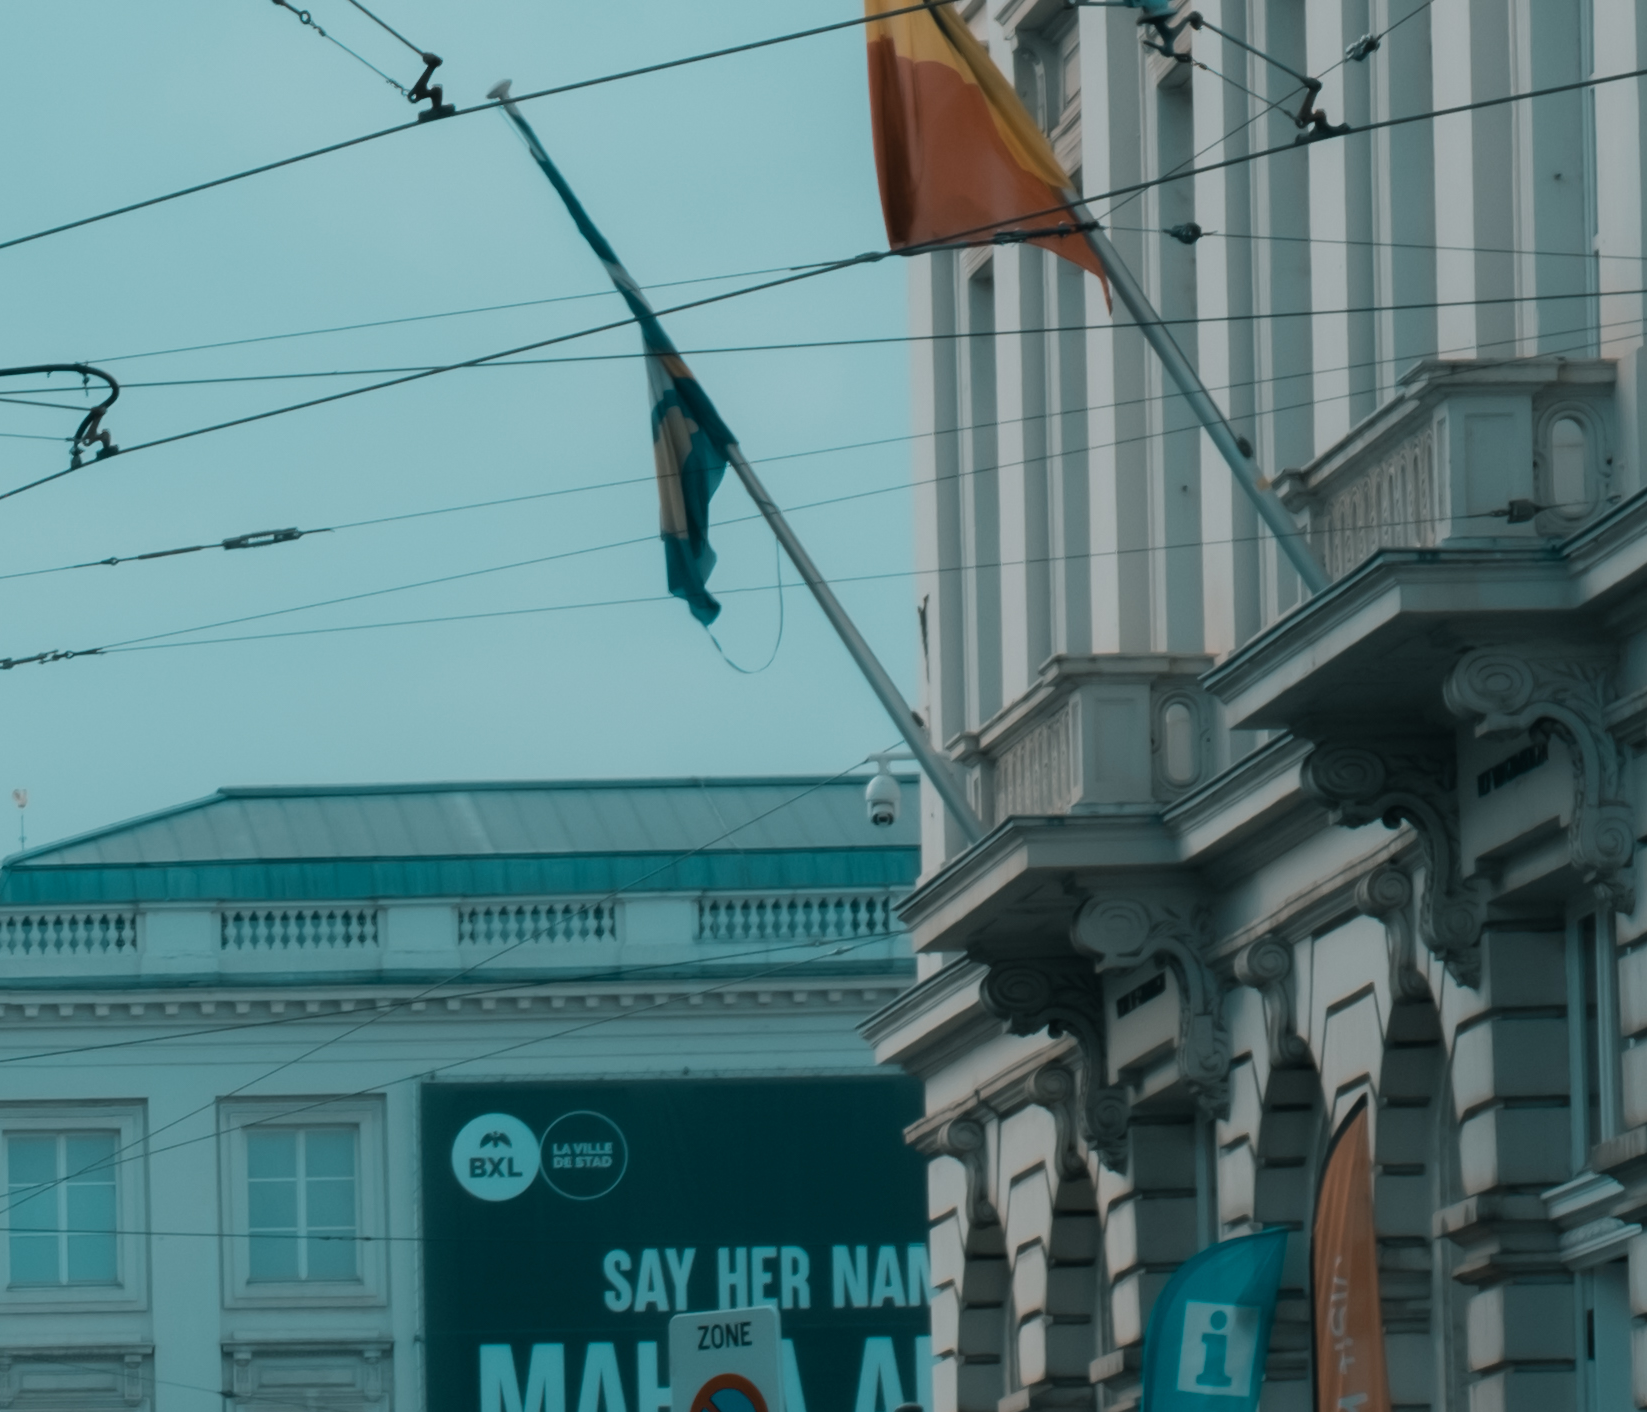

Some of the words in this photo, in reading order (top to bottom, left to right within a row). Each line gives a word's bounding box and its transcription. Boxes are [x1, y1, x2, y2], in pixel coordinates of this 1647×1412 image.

[553, 1143, 571, 1155] LA
[573, 1142, 613, 1154] VILLE
[469, 1157, 523, 1178] BXL
[553, 1157, 572, 1168] DE
[575, 1156, 612, 1168] STAD
[603, 1247, 696, 1312] SAY
[718, 1245, 811, 1310] HER
[697, 1322, 752, 1350] ZONE
